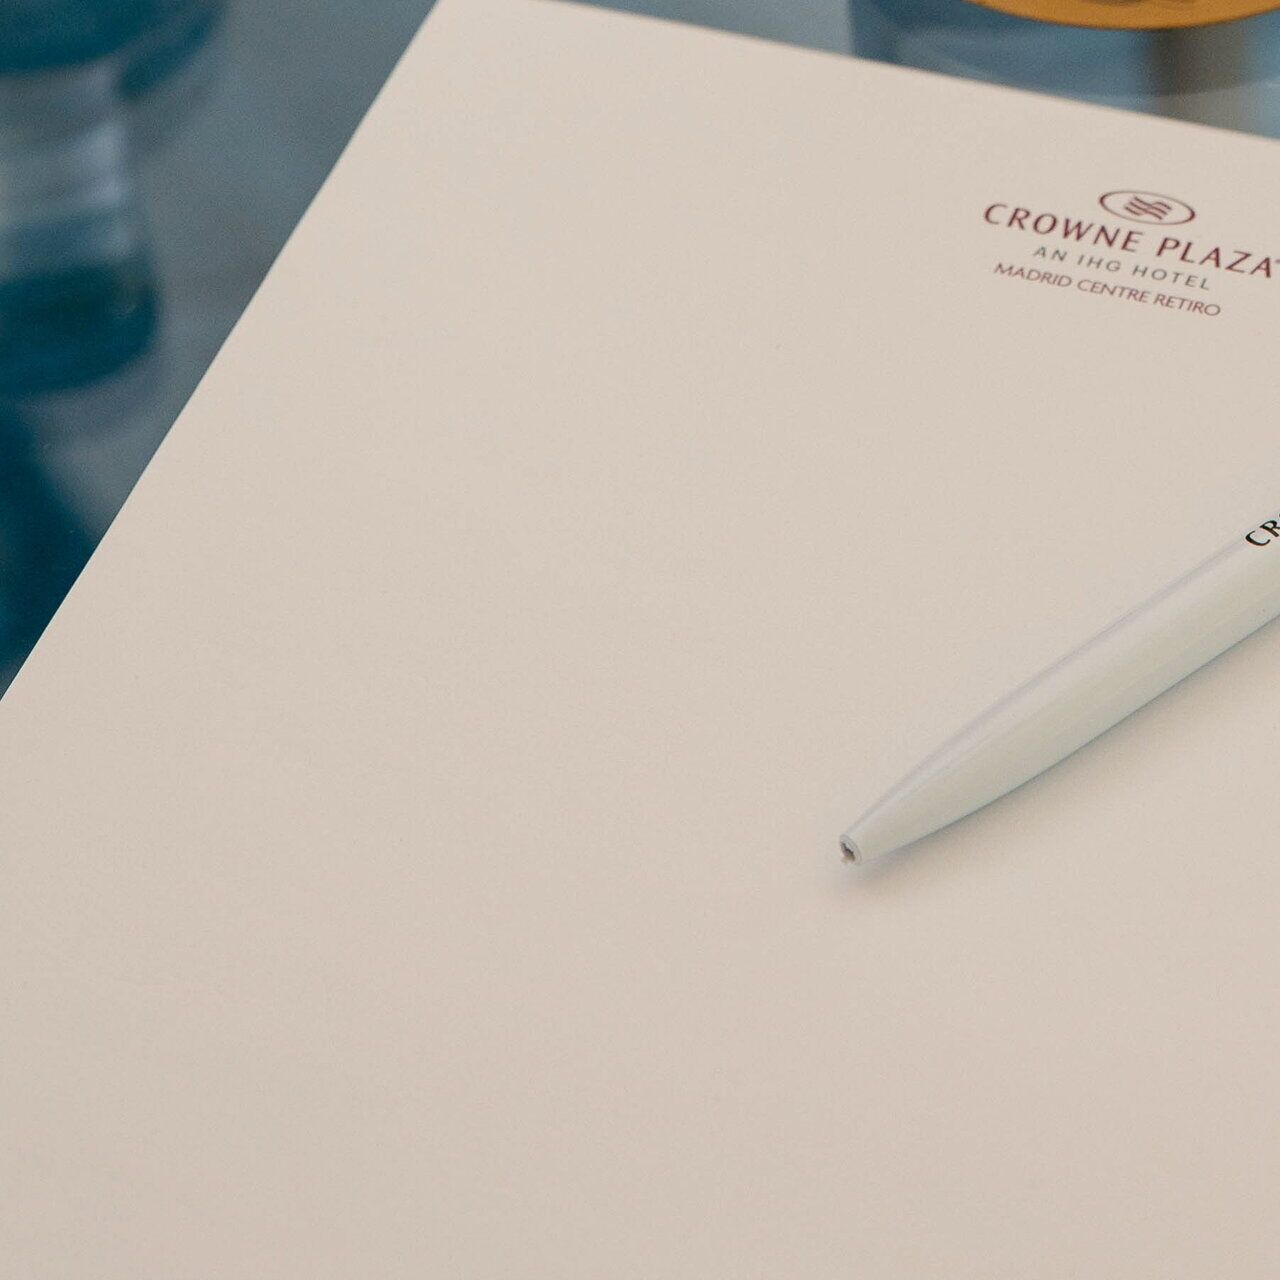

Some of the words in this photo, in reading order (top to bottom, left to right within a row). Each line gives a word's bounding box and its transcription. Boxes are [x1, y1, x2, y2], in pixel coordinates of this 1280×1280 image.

[984, 203, 1144, 253] CROWNE
[1155, 236, 1276, 279] PLAZA
[1033, 245, 1068, 263] AN
[1077, 253, 1122, 273] IHG
[1131, 264, 1211, 291] HOTEL
[993, 262, 1073, 288] MADRID
[1076, 278, 1150, 303] CENTRE
[1153, 292, 1221, 317] RETIRO
